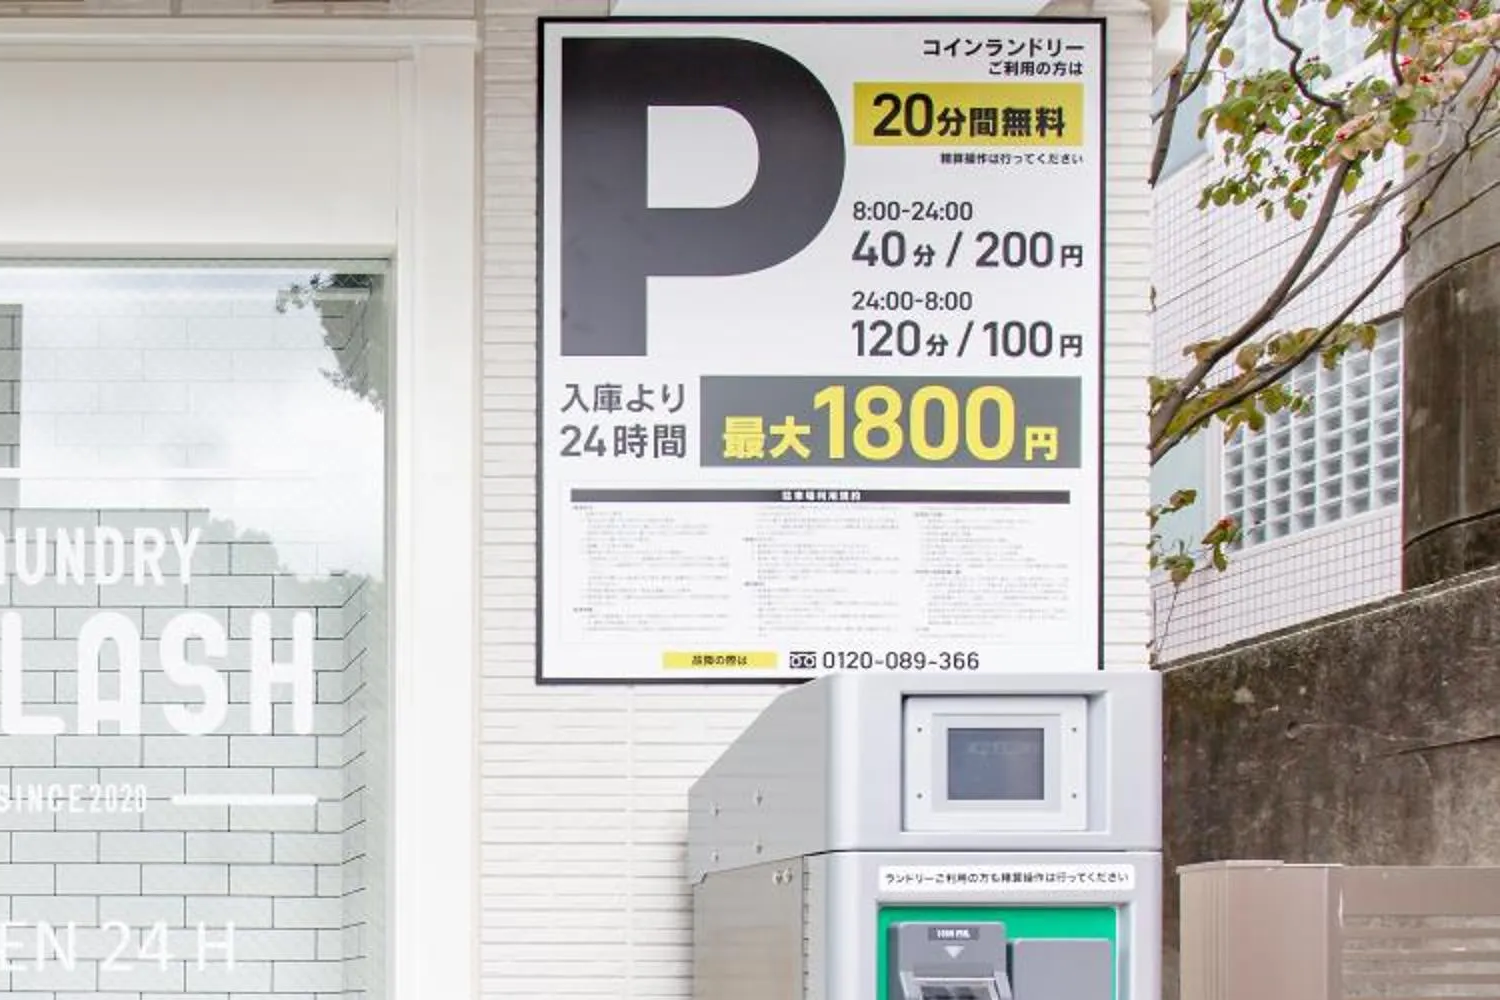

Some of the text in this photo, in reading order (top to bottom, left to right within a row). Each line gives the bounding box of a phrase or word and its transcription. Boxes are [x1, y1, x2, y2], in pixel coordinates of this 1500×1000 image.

[923, 37, 1085, 58] コインランドリー
[988, 60, 1083, 77] ご利用の方は
[873, 92, 1065, 138] 20分間無料
[560, 36, 846, 356] P
[852, 200, 973, 221] 8:00-24:00
[852, 290, 973, 311] 24:00-8:00
[560, 383, 685, 414] 入庫より
[724, 384, 1059, 461] 最大1800円
[560, 423, 687, 459] 24時間
[822, 651, 980, 671] 0120-089-366
[102, 919, 175, 972] 24
[198, 920, 237, 971] H
